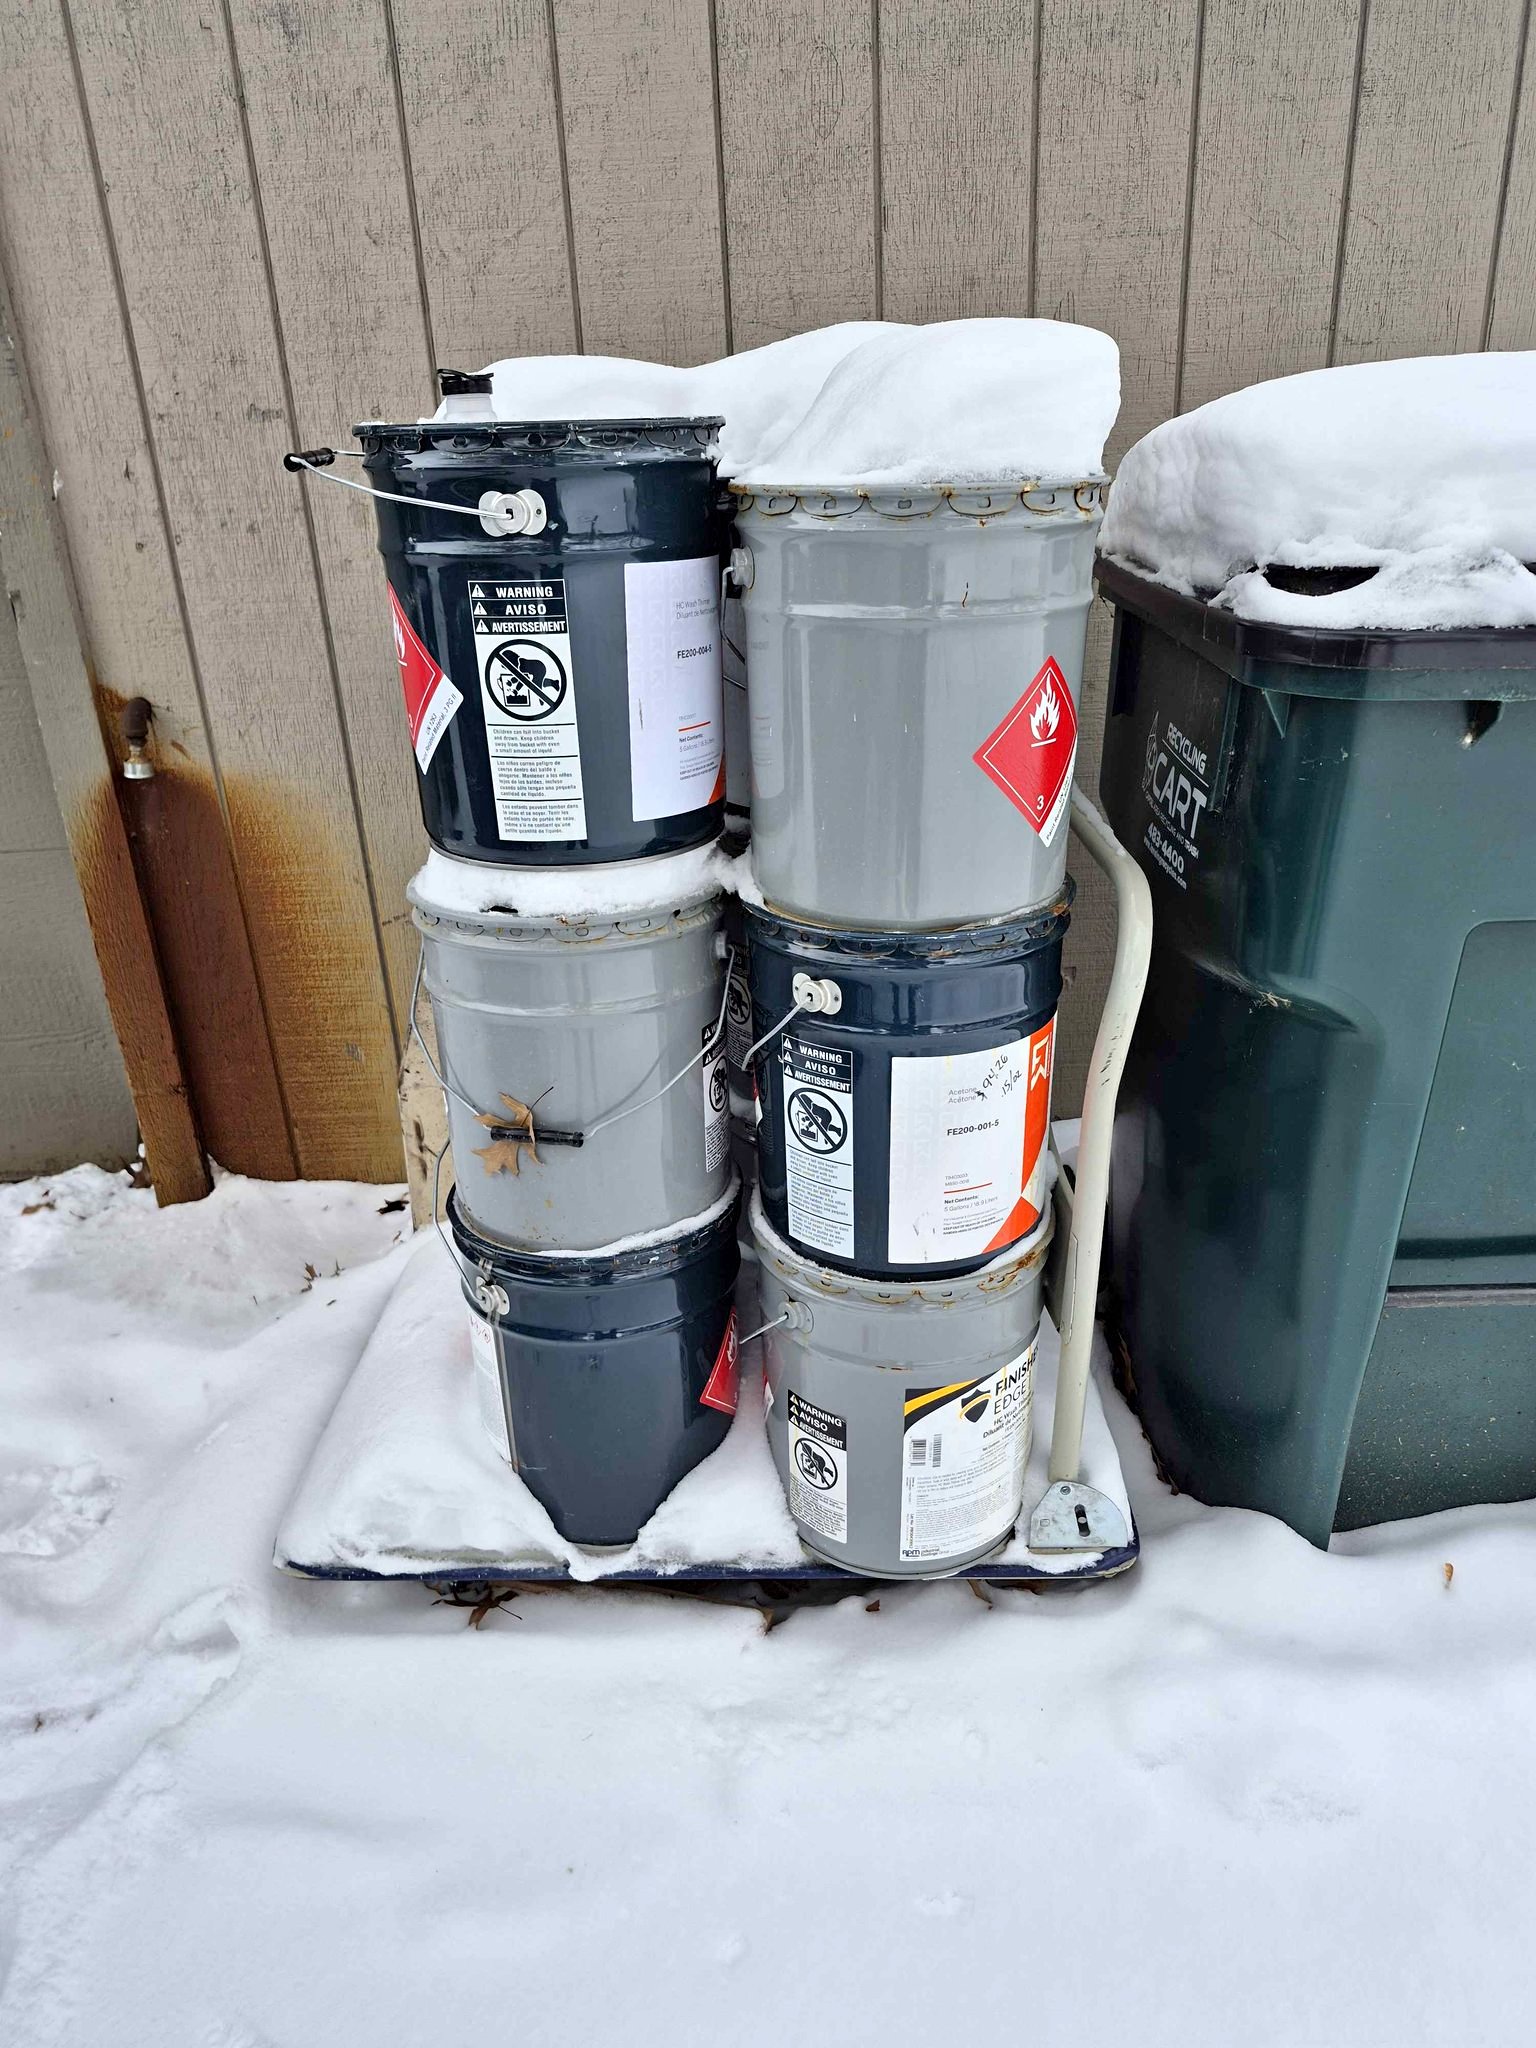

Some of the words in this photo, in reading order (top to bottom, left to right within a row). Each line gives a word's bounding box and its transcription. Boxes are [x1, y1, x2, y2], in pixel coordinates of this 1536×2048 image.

[496, 587, 553, 598] WARNING
[506, 604, 546, 615] AVISO
[492, 621, 566, 632] AVERTISSEMENT
[1167, 722, 1207, 775] RECYCLING
[1036, 794, 1044, 810] 3
[1152, 752, 1208, 840] CART
[1148, 822, 1184, 874] 483-4400
[800, 1044, 842, 1064] WARNING
[804, 1060, 836, 1076] AVISO
[794, 1070, 850, 1092] AVERTISSEMENT
[948, 1087, 977, 1096] Acetone
[948, 1095, 977, 1104] Acétone
[947, 1119, 1000, 1136] FE200-001-5
[994, 1378, 1027, 1415] EDGE
[799, 1400, 842, 1427] WARNING
[800, 1412, 828, 1432] AVISO
[800, 1422, 843, 1448] AVERTISSEMENT
